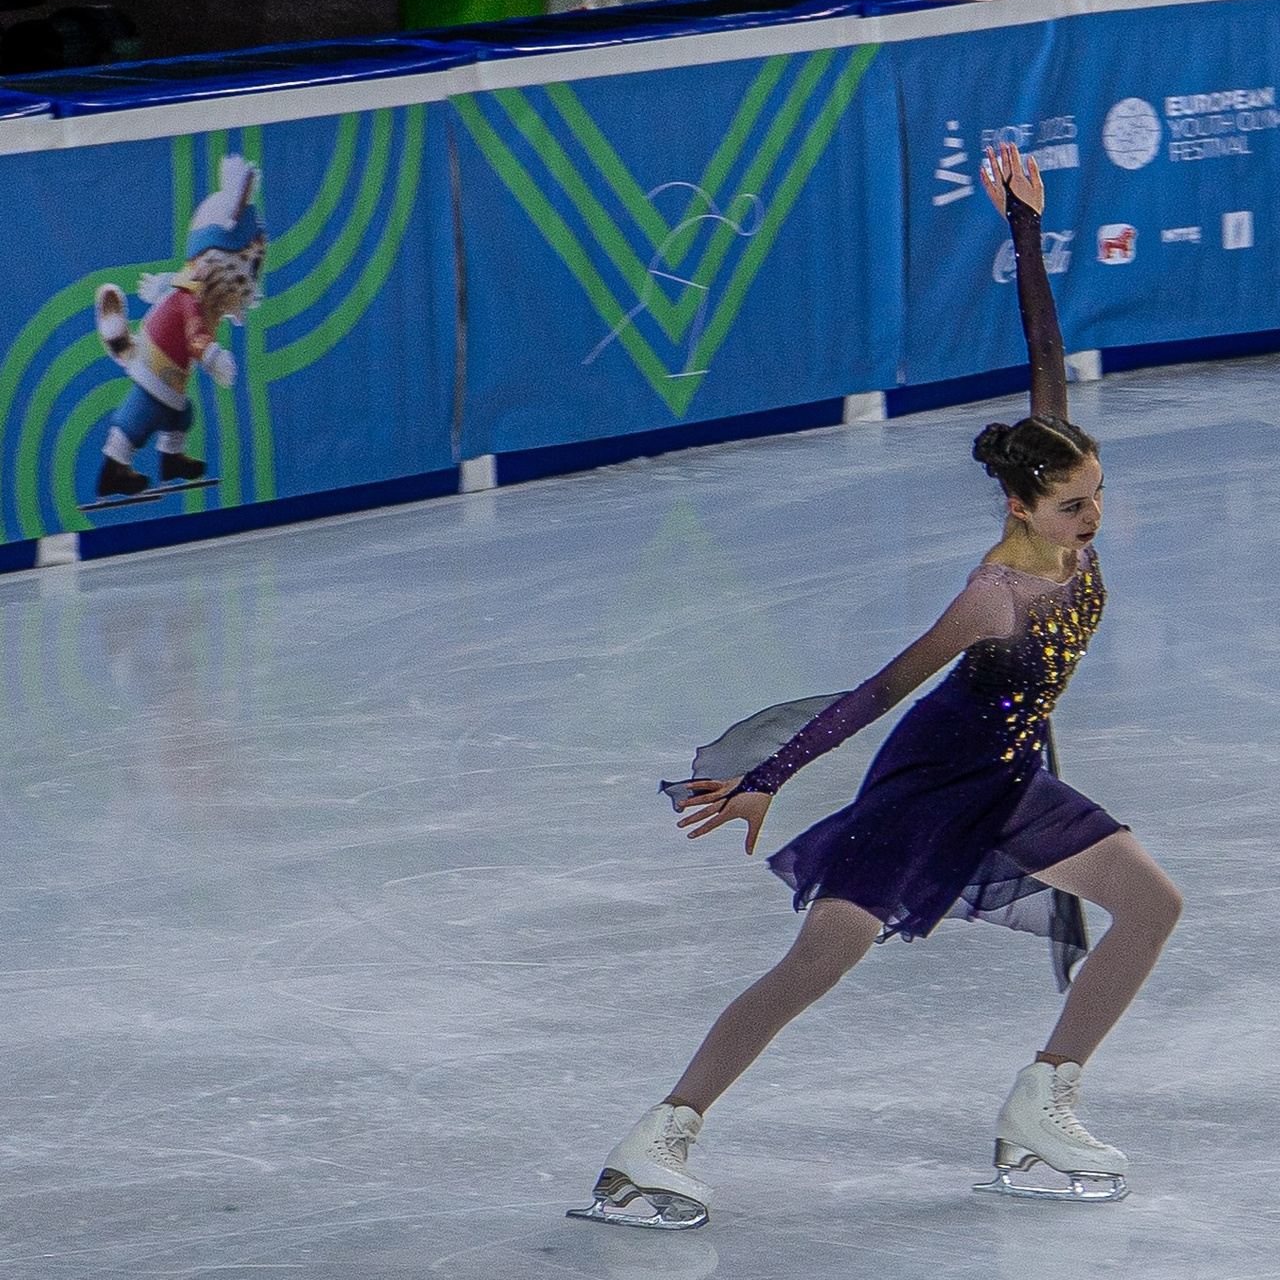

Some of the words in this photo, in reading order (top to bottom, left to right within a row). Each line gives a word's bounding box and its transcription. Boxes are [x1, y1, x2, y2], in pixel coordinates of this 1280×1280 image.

[1165, 87, 1276, 117] EUROPEAN
[1167, 114, 1234, 138] YOUTH
[1169, 136, 1252, 162] FESTIVAL
